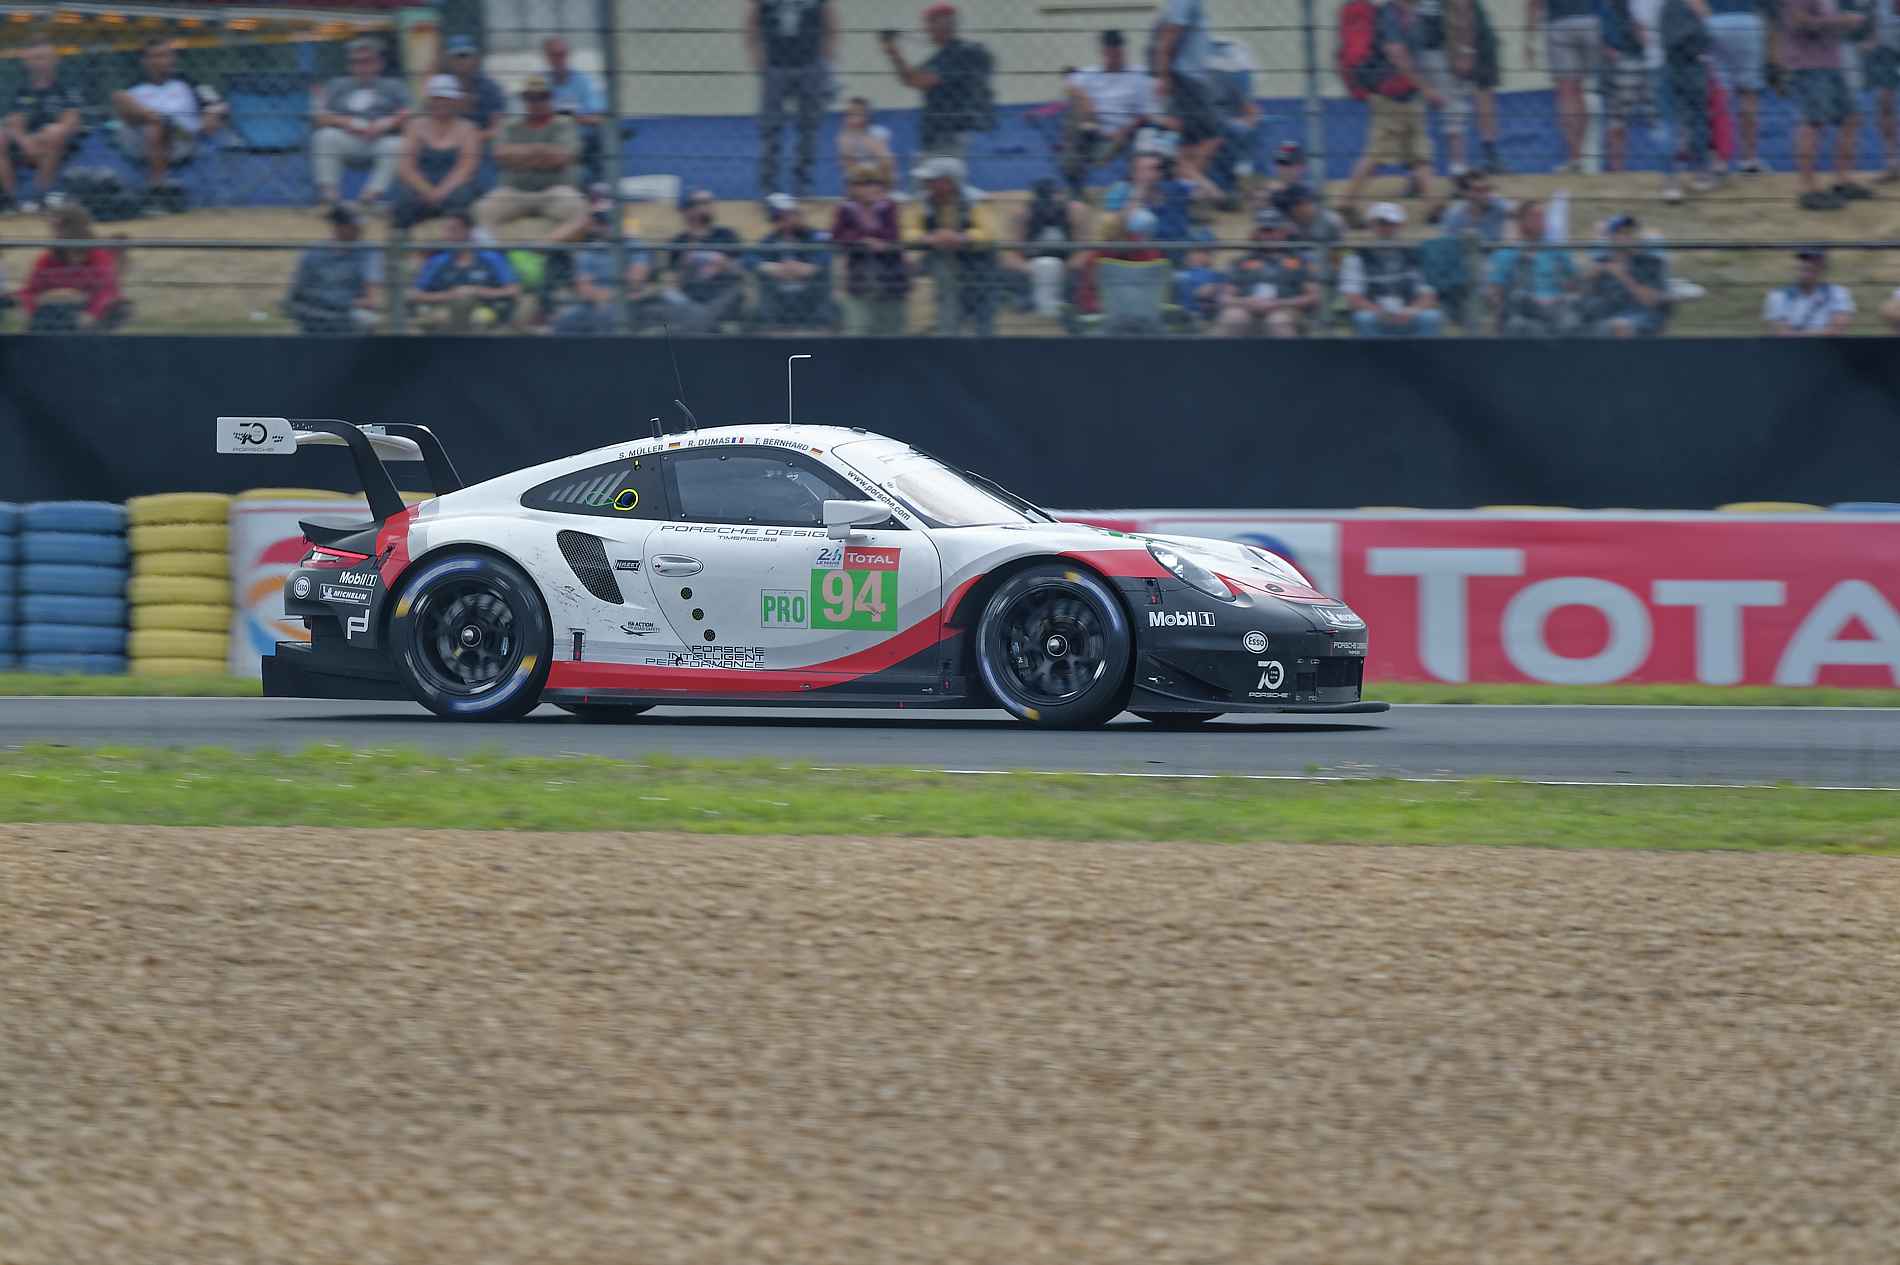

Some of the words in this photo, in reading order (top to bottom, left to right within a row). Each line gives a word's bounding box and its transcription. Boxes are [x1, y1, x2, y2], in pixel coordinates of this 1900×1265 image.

[698, 437, 730, 446] DUMAS
[754, 437, 761, 445] T.
[763, 438, 809, 451] BERNHARD
[628, 444, 664, 457] MÜLLER
[847, 470, 911, 521] www.porsche.com
[661, 525, 758, 535] PORSCHE
[765, 528, 829, 538] DESIG
[847, 552, 895, 564] TOTAL
[339, 571, 367, 586] Mobil
[333, 590, 368, 600] MICHELIN
[822, 570, 886, 622] 94
[763, 595, 806, 623] PRO
[1149, 611, 1197, 627] Mobil
[692, 645, 765, 653] PORSCHE
[645, 658, 765, 668] PERFORMANCE
[668, 652, 765, 661] INTELLIGENT
[1257, 660, 1285, 690] 70
